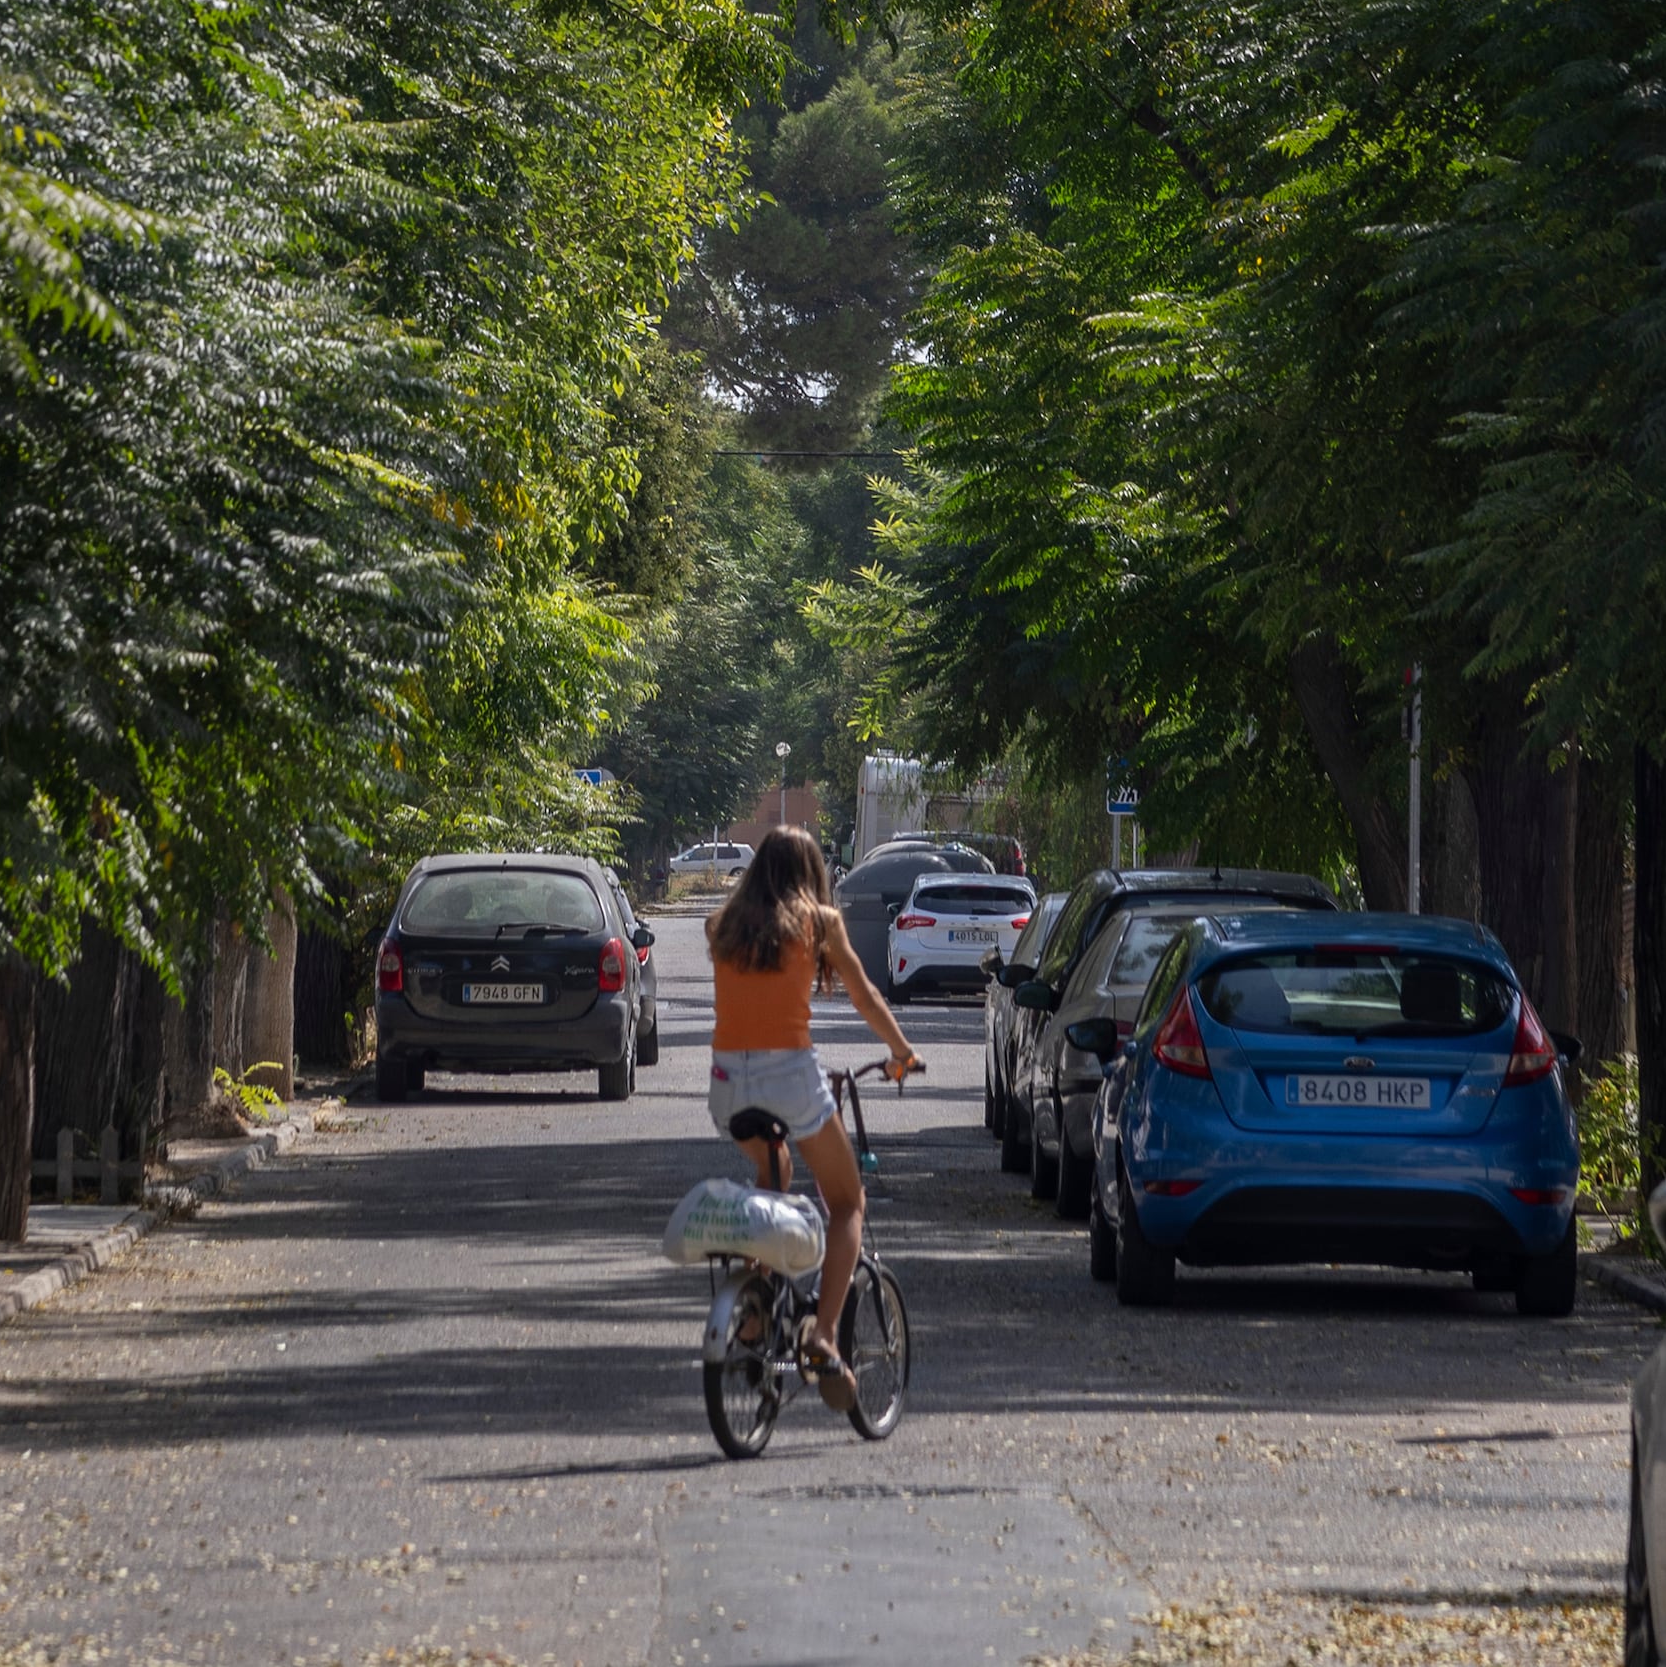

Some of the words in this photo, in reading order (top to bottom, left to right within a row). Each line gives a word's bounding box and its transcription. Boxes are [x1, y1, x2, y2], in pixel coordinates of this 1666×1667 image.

[473, 986, 508, 1000] 7948
[513, 986, 540, 1000] GFN
[1304, 1080, 1367, 1102] 8408
[1378, 1081, 1424, 1104] HKP
